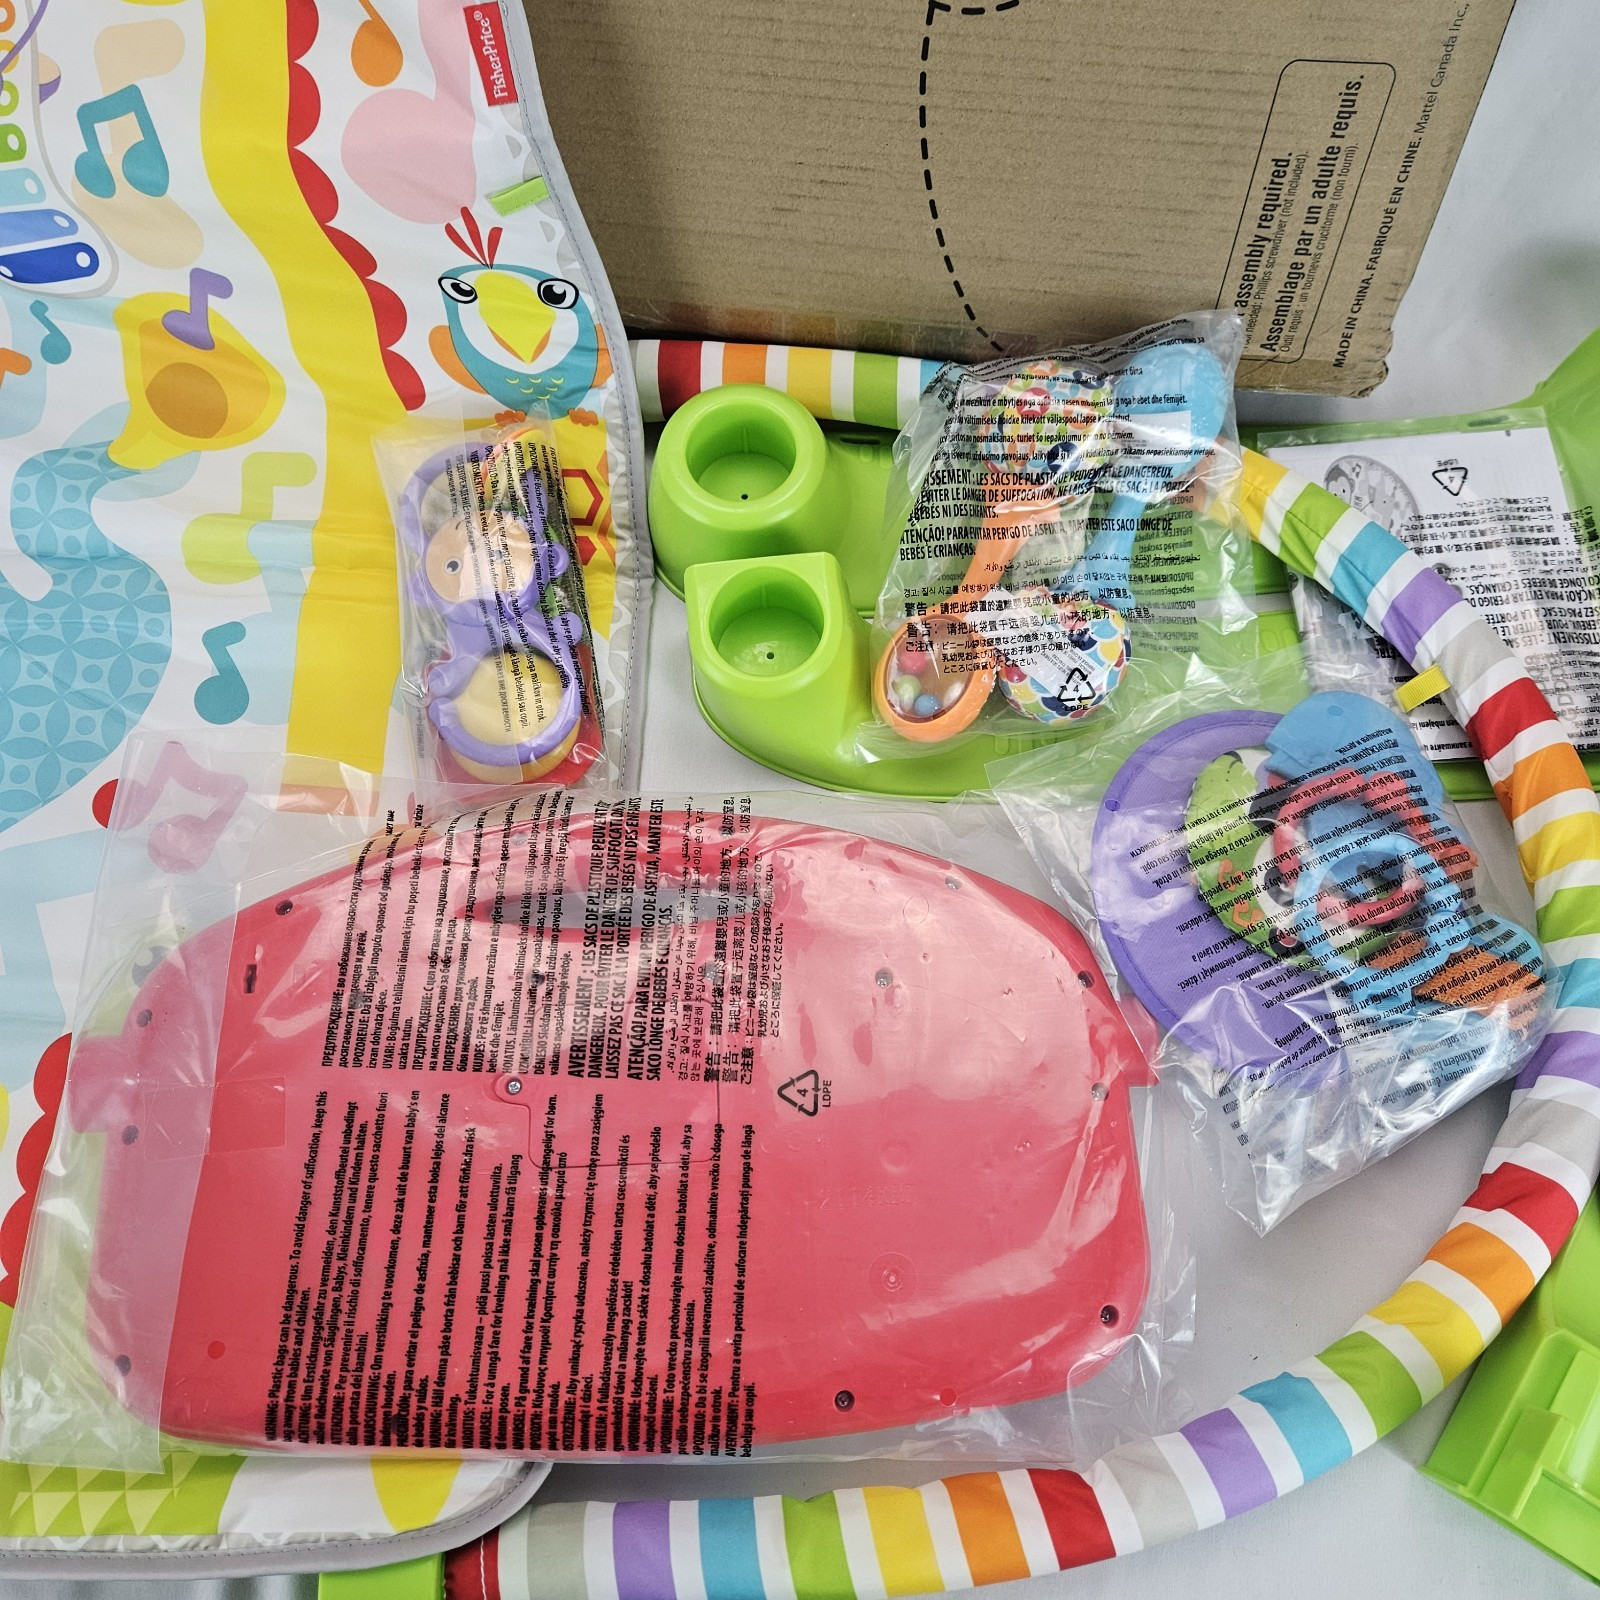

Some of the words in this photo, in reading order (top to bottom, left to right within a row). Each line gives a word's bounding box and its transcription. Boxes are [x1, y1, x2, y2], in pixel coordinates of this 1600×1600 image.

[1329, 75, 1364, 138] requis.
[1311, 146, 1340, 199] adulte
[1336, 143, 1359, 176] fourni).
[1287, 151, 1309, 196] included).
[1333, 332, 1352, 368] MADE
[1344, 317, 1358, 330] IN
[1351, 274, 1374, 313] CHINA.
[1366, 208, 1397, 271] FABRIQUÉ
[1390, 187, 1404, 203] EN
[1397, 137, 1422, 183] CHINE.
[1413, 92, 1438, 133] Mattel
[1431, 36, 1457, 88] Canada
[1449, 3, 1469, 31] Inc.,
[1330, 180, 1346, 200] (non
[1281, 199, 1294, 216] (not
[1303, 205, 1322, 225] un
[1234, 235, 1271, 307] assembly
[1257, 152, 1292, 228] required.
[1314, 203, 1338, 250] cruciforme
[1265, 219, 1287, 268] screwdriver
[1294, 230, 1314, 256] par
[1254, 271, 1272, 299] Phillips
[1300, 253, 1322, 290] tournevis
[1260, 262, 1304, 352] Assemblage
[1299, 293, 1309, 302] un
[1245, 302, 1262, 332] needed:
[1288, 310, 1303, 333] requis
[1280, 335, 1294, 352] Outil
[976, 473, 988, 486] LES
[990, 473, 1010, 486] SACS
[1012, 473, 1023, 485] DE
[1124, 466, 1173, 478] DANGEREUX.
[962, 489, 986, 501] DANGER
[988, 490, 998, 502] DE
[954, 504, 968, 517] DES
[970, 505, 998, 519] ENFANTS.
[900, 525, 944, 546] ATENÇÃO!
[947, 527, 969, 540] PARA
[970, 528, 990, 540] EVITAR
[992, 527, 1020, 540] PERIGO
[1101, 518, 1115, 531] ESTE
[1117, 518, 1135, 531] SACO
[1137, 519, 1161, 531] LONGE
[900, 546, 925, 561] BEBÉS
[928, 548, 932, 558] E
[934, 544, 976, 559] CRIANÇAS.
[592, 807, 607, 850] PEUVENT
[622, 830, 639, 847] DES
[646, 815, 663, 854] MANTER
[622, 850, 637, 860] NI
[587, 852, 603, 905] PLASTIQUE
[604, 873, 618, 885] DE
[644, 857, 662, 897] ASFIXIA,
[586, 908, 600, 920] DE
[602, 888, 618, 927] DANGER
[618, 896, 634, 913] DES
[643, 899, 657, 911] DE
[583, 923, 598, 948] SACS
[599, 930, 614, 942] LE
[614, 915, 632, 954] PORTÉE
[639, 914, 656, 951] PERIGO
[581, 949, 595, 967] LES
[594, 944, 613, 979] ÉVITER
[615, 956, 629, 968] LA
[637, 953, 653, 988] EVITAR
[594, 981, 609, 1009] POUR
[612, 979, 627, 998] SAC
[651, 967, 669, 999] BEBÉS
[375, 990, 387, 1012] djece.
[610, 1001, 625, 1012] CE
[634, 991, 650, 1018] PARA
[651, 1001, 666, 1014] DE
[371, 1014, 384, 1045] dohvata
[401, 1017, 413, 1041] tutun.
[568, 975, 594, 1077] AVERTISSEMENT
[609, 1015, 624, 1034] PAS
[649, 1016, 665, 1051] LONGE
[366, 1048, 379, 1068] izvan
[382, 1043, 395, 1068] UYARI:
[398, 1043, 409, 1069] uzakta
[588, 1011, 607, 1078] DANGEREUX.
[605, 1037, 622, 1079] LAISSEZ
[627, 1021, 650, 1080] ATENÇÃO!
[647, 1054, 662, 1081] SACO
[316, 1091, 328, 1106] this
[822, 1080, 831, 1107] LDPE
[311, 1108, 328, 1128] keep
[342, 1102, 358, 1144] unbedingt
[304, 1130, 323, 1179] suffocation,
[302, 1180, 312, 1189] of
[328, 1146, 351, 1217] Kunststoffbeutel
[296, 1191, 312, 1221] danger
[293, 1224, 305, 1248] avoid
[325, 1219, 338, 1235] den
[289, 1250, 301, 1260] To
[318, 1238, 336, 1287] vermeiden,
[282, 1262, 299, 1311] dangerous.
[317, 1289, 328, 1300] zu
[280, 1314, 291, 1325] be
[295, 1287, 311, 1327] children.
[279, 1327, 289, 1342] can
[292, 1328, 305, 1346] and
[303, 1301, 326, 1383] Erstickungsgefahr
[273, 1345, 288, 1366] bags
[287, 1348, 301, 1378] babies
[268, 1368, 283, 1398] Plastic
[283, 1380, 297, 1402] from
[300, 1386, 314, 1401] Um
[265, 1400, 278, 1441] WARNING:
[284, 1405, 296, 1428] away
[298, 1403, 312, 1443] ACHTUNG:
